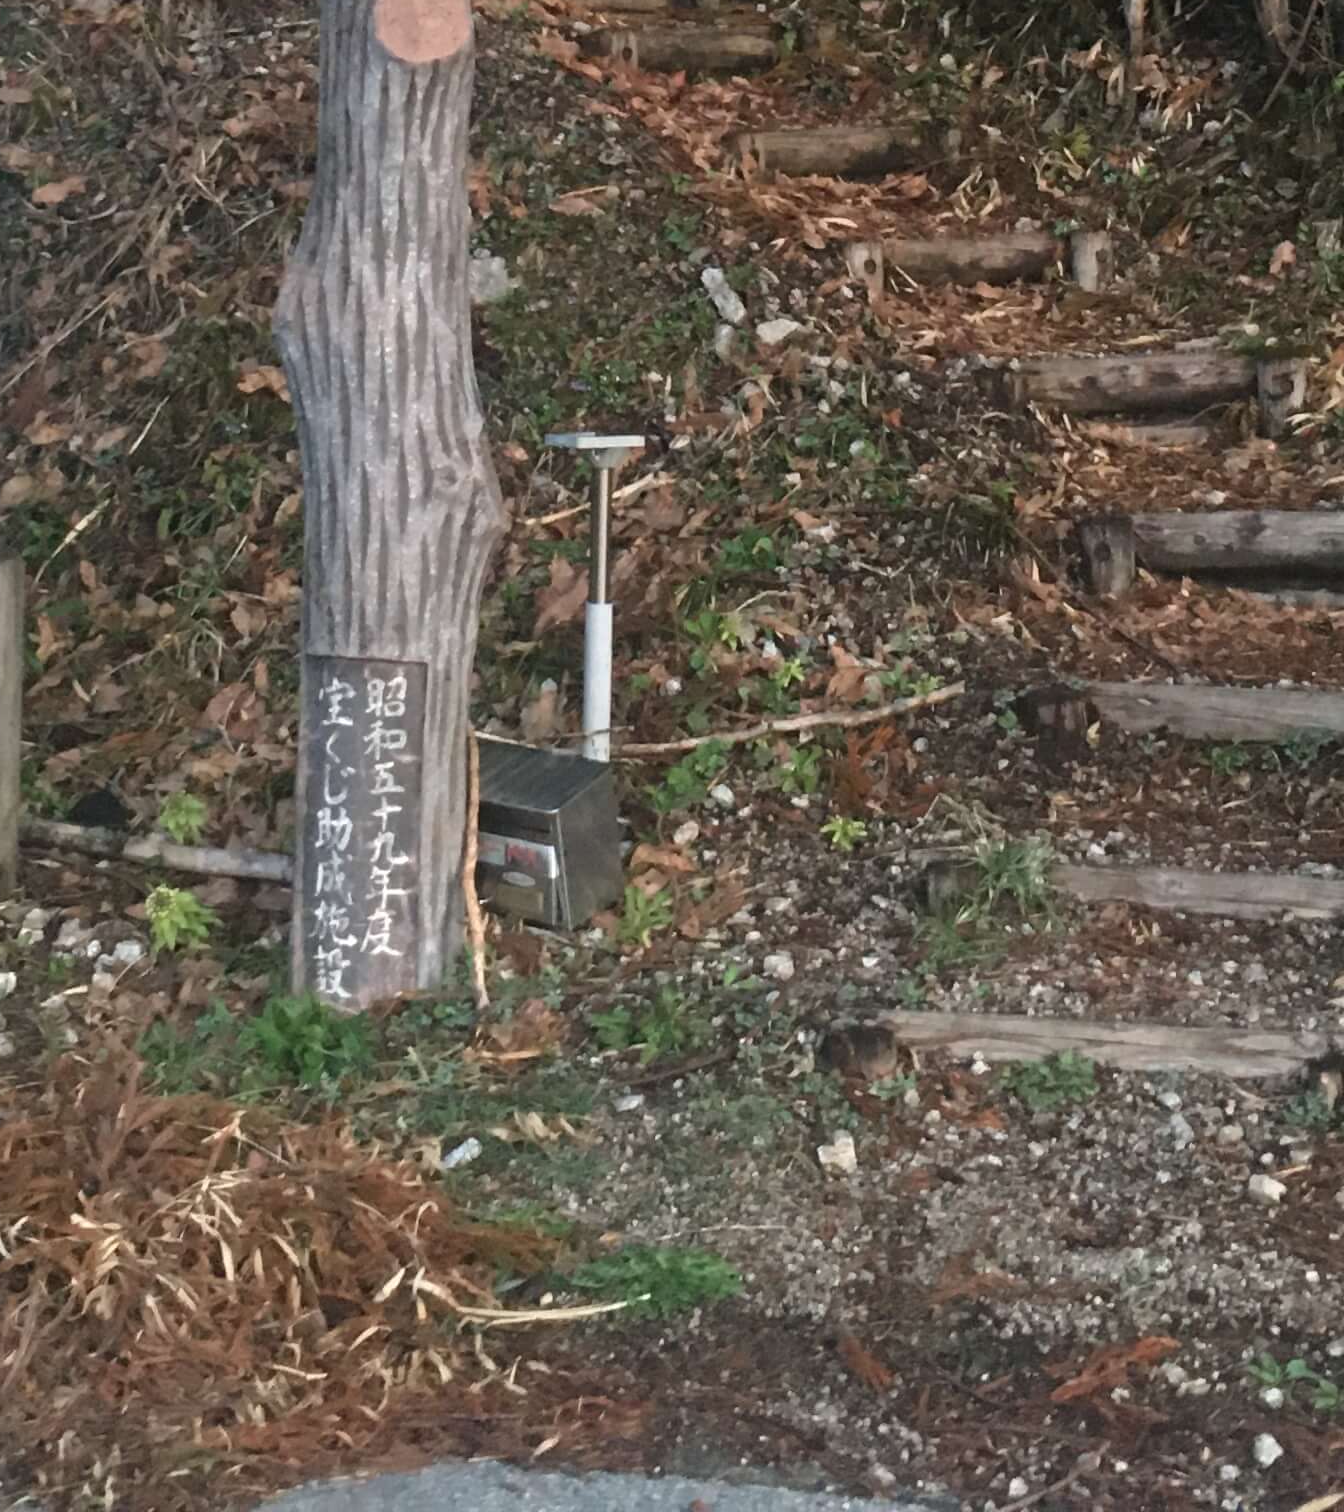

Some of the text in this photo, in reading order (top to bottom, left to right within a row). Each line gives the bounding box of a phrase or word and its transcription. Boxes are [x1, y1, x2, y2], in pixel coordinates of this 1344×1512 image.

[312, 678, 358, 999] 宝くじ助成施設
[361, 677, 410, 957] 昭和五十九年度
